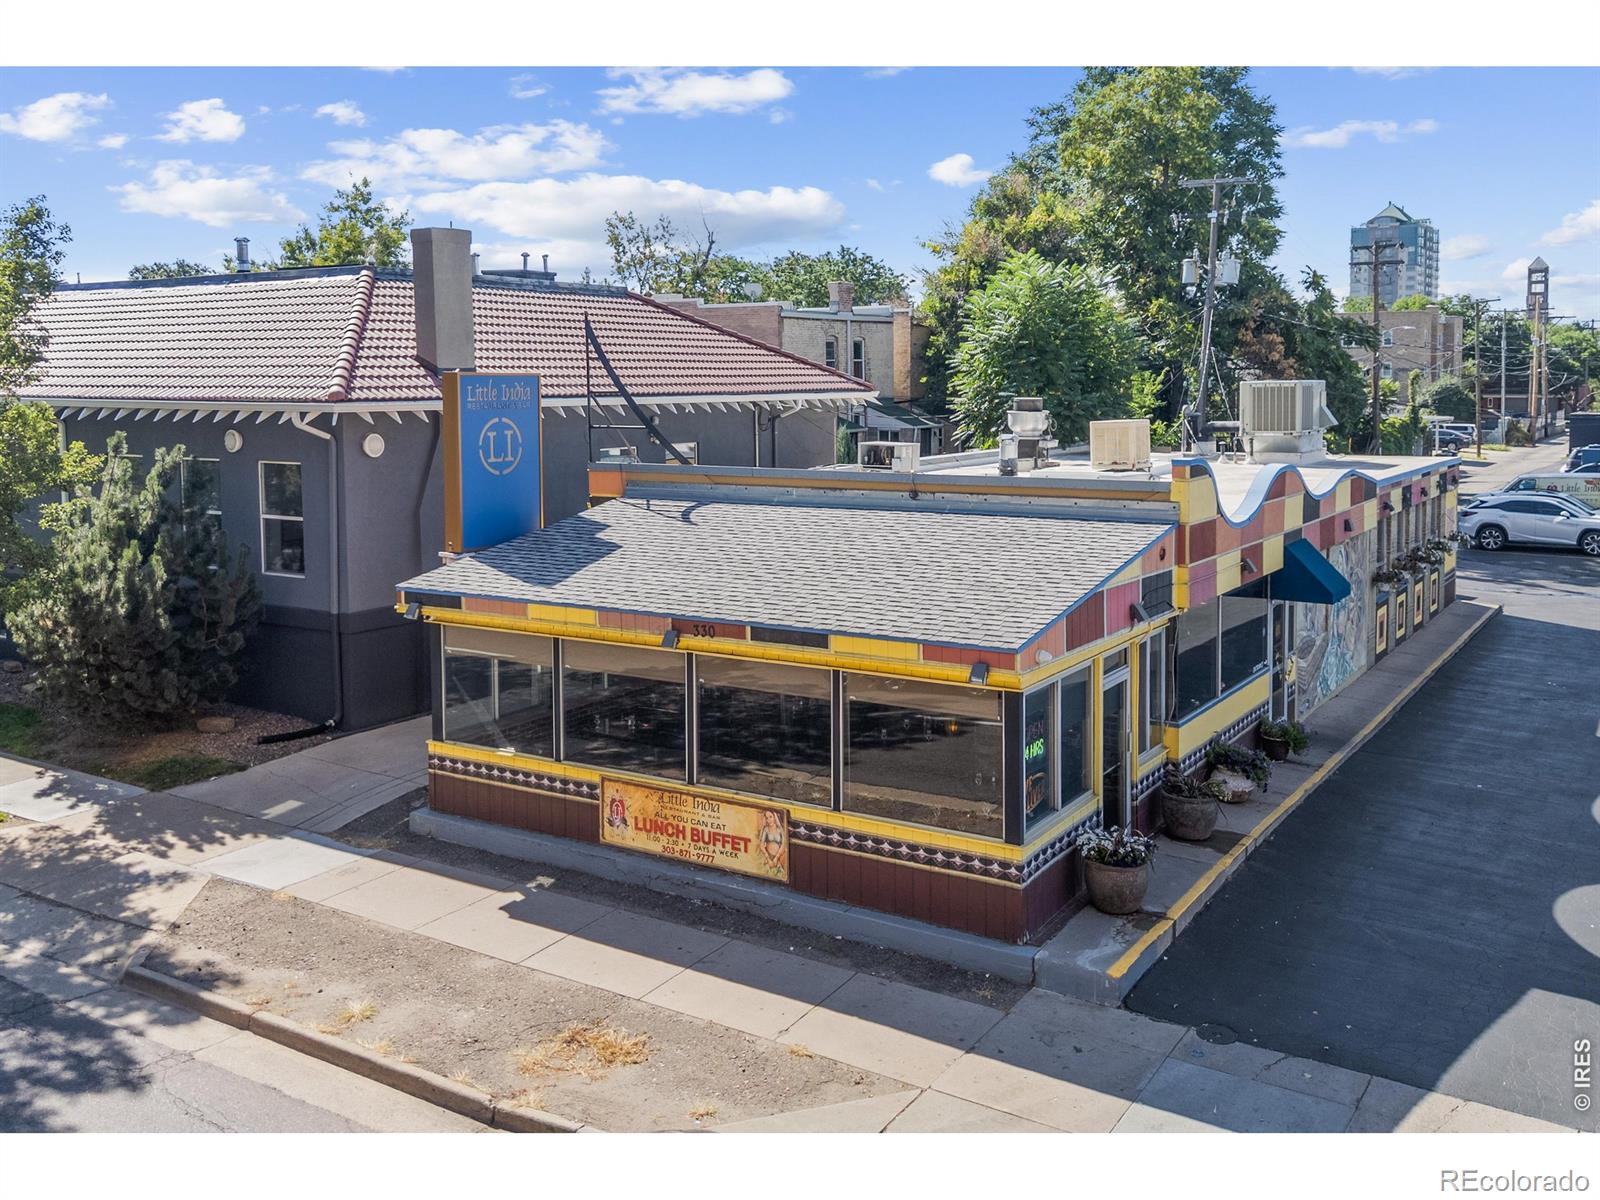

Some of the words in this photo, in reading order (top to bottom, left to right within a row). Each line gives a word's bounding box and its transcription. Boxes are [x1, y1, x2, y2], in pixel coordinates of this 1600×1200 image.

[467, 379, 497, 400] Little
[502, 381, 530, 400] India
[487, 430, 514, 462] LI
[692, 623, 715, 639] 330
[660, 790, 688, 808] Little
[692, 796, 720, 813] India
[654, 808, 668, 821] ALL
[671, 813, 688, 824] YOU
[691, 818, 709, 828] CAN
[711, 822, 727, 831] EAT
[633, 815, 686, 841] LUNCH
[690, 827, 752, 854] BUFFET
[661, 845, 715, 864] 303-871-9777
[693, 845, 710, 855] DAYS
[719, 849, 740, 860] WEEK
